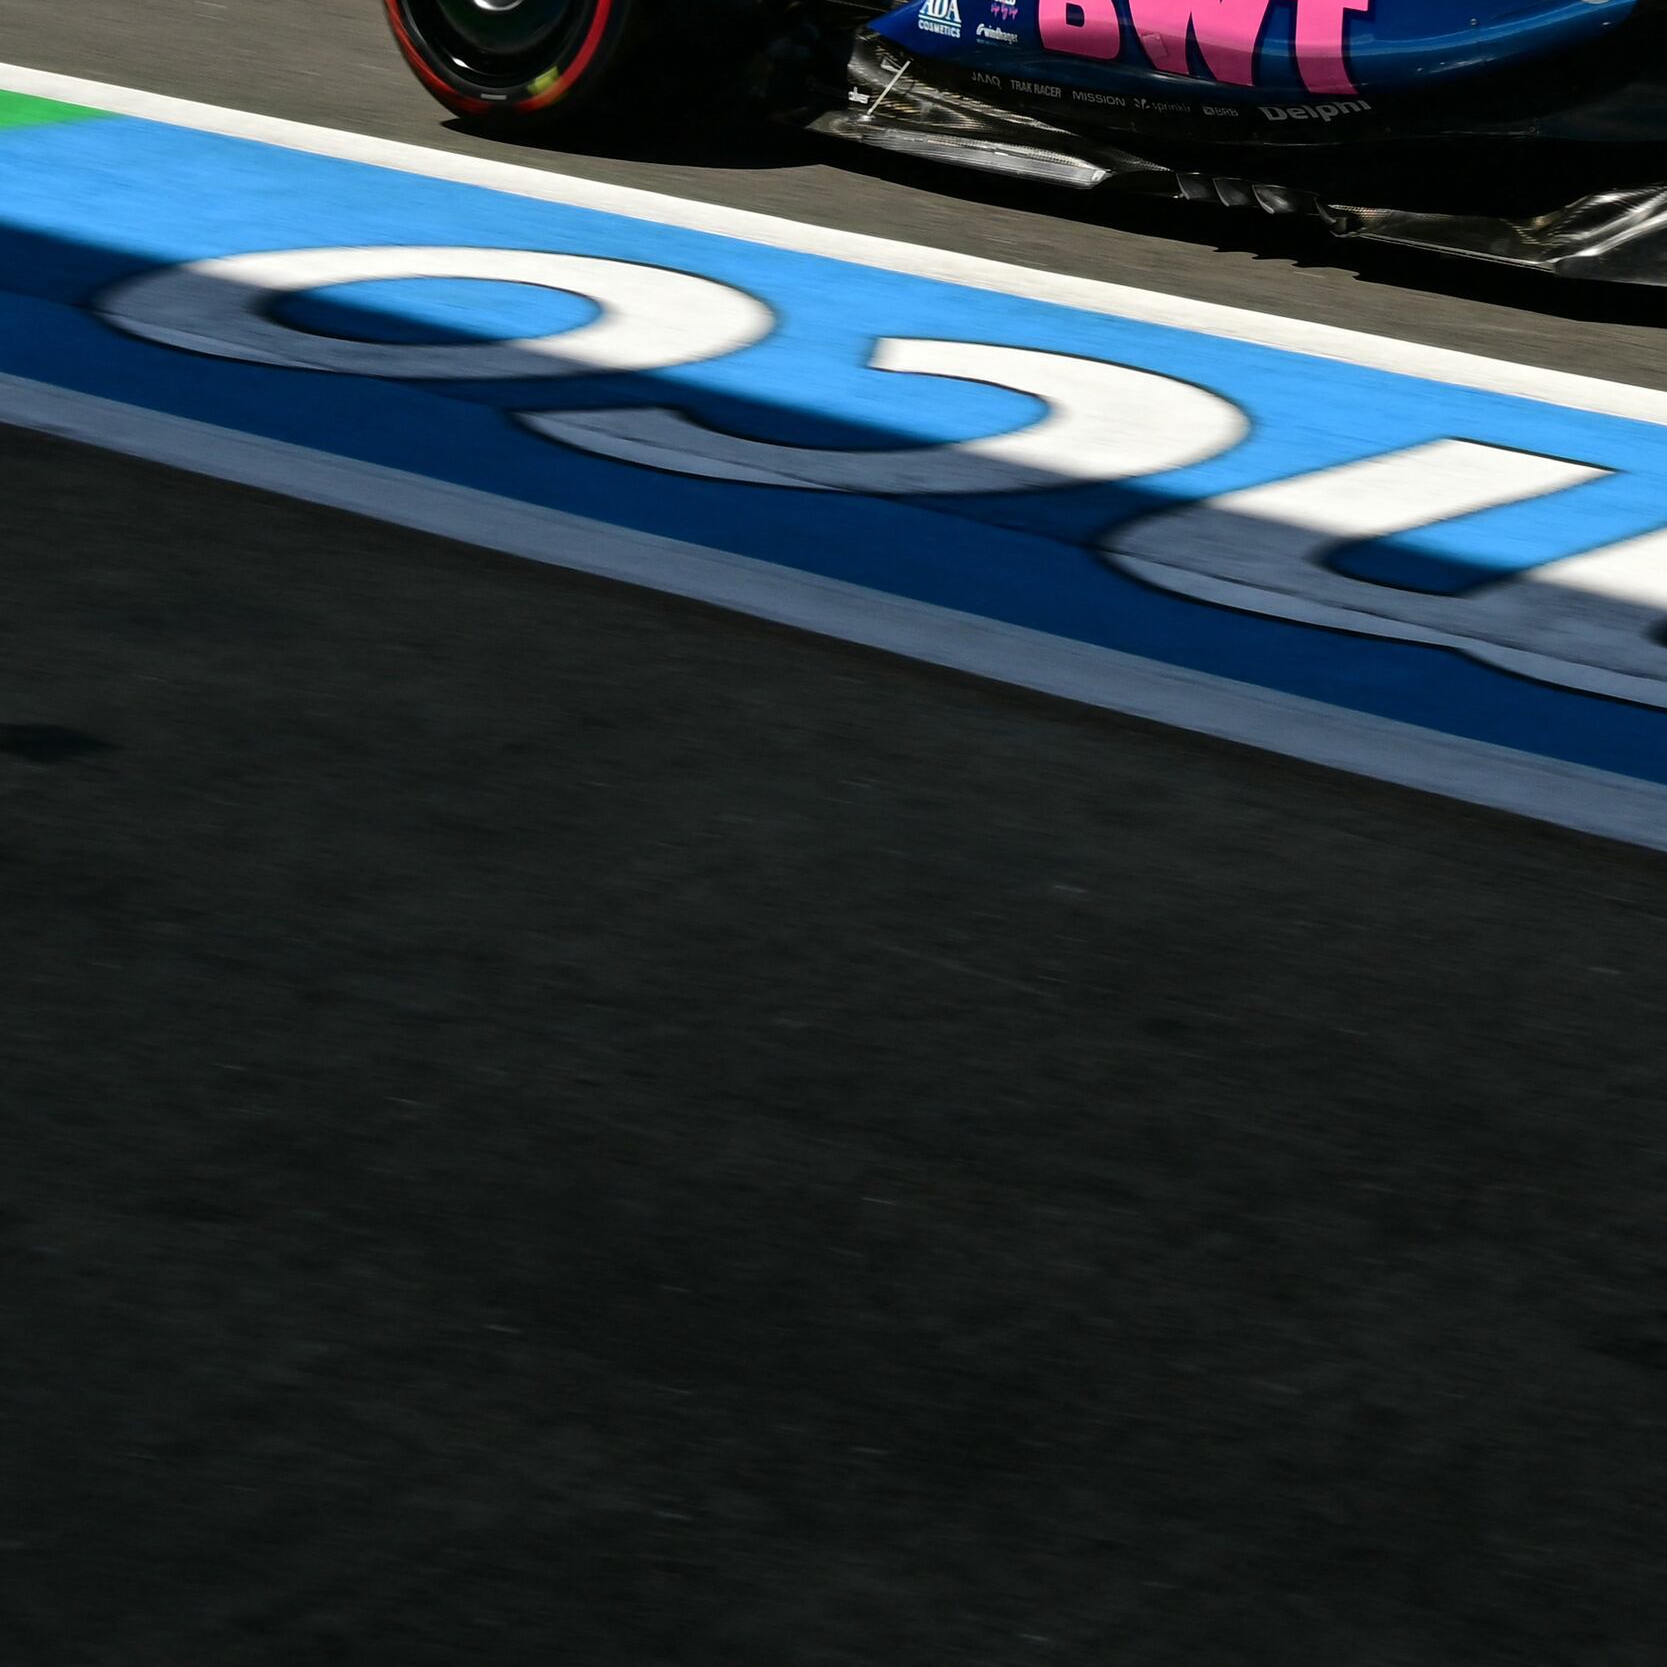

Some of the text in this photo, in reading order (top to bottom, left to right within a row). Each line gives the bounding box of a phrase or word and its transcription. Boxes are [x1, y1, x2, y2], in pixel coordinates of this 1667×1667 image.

[918, 20, 961, 39] COSMETICS
[1033, 83, 1062, 99] RACER
[1072, 90, 1126, 108] MISSION
[1259, 100, 1371, 124] Delphi
